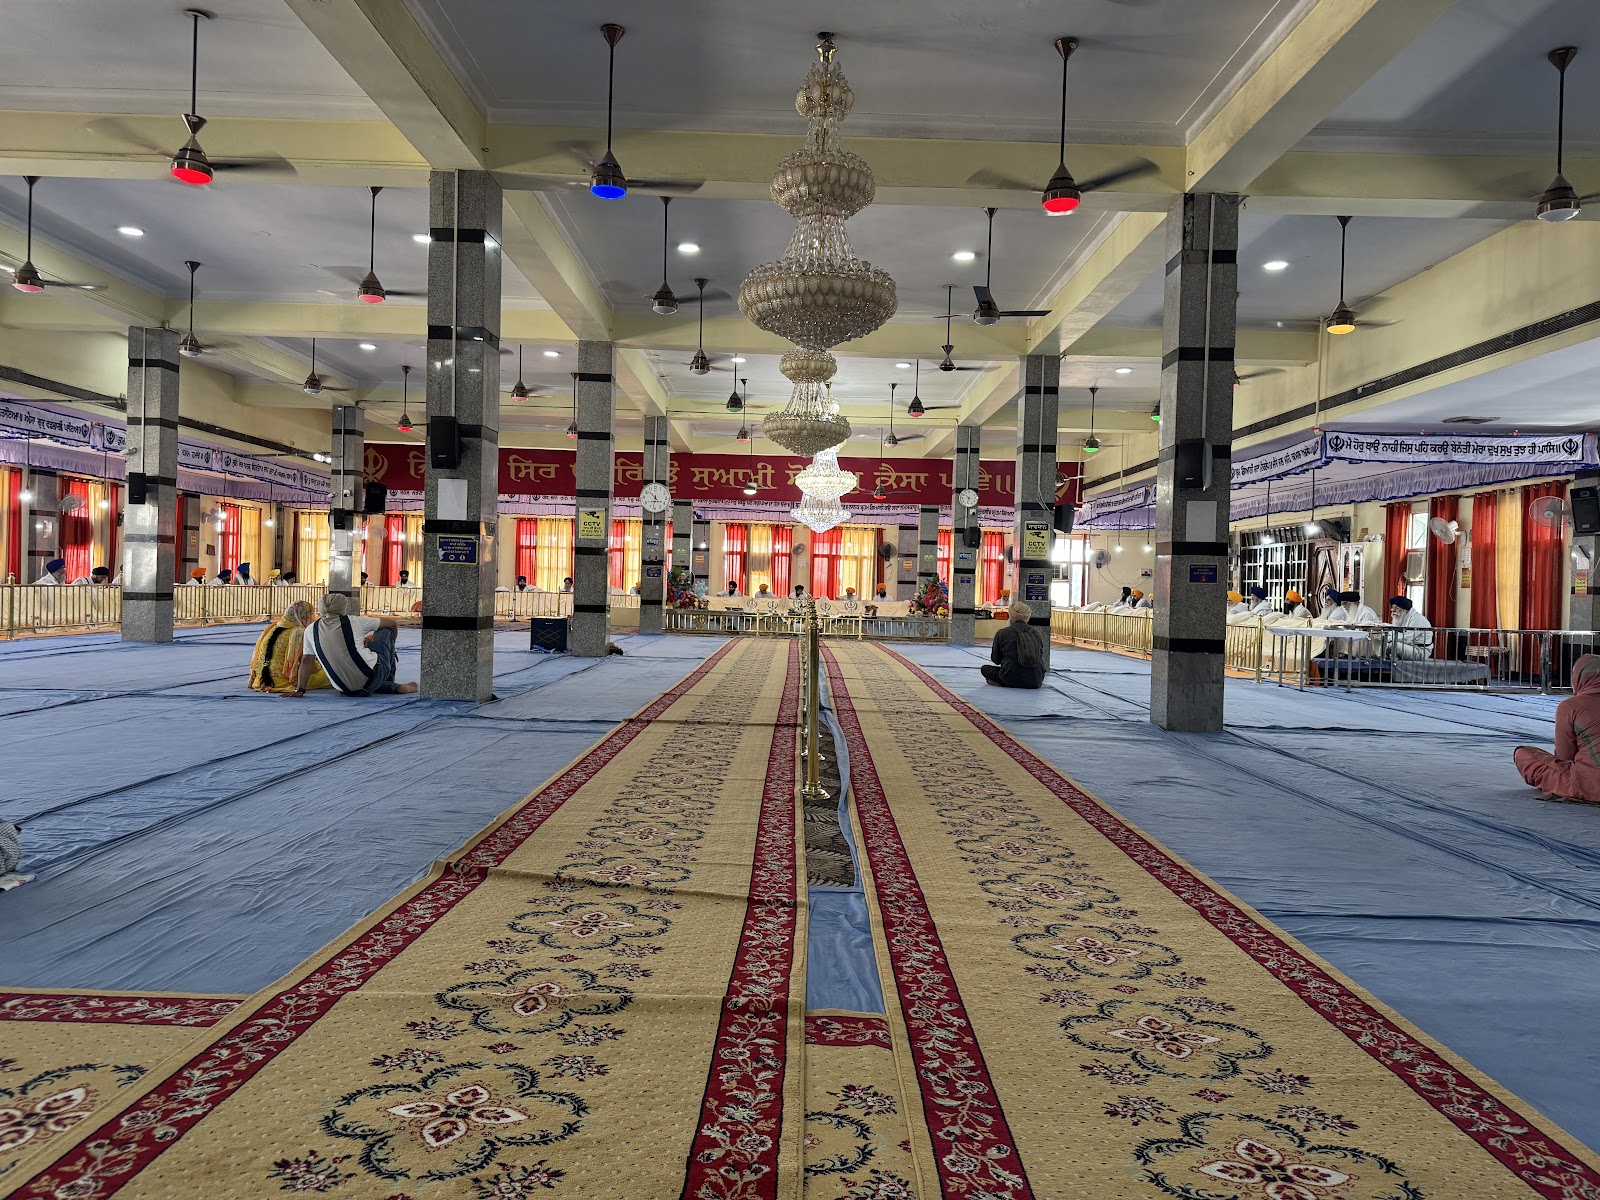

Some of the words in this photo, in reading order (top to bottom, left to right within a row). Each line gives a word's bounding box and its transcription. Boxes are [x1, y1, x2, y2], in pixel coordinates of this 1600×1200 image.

[1345, 436, 1353, 450] ਮੈ
[1353, 437, 1365, 452] ਹੋਰੁ
[1381, 439, 1398, 453] ਨਾਹੀ
[1399, 440, 1413, 454] ਜਿਸੁ
[1414, 440, 1430, 453] ਪਹਿ
[1429, 440, 1449, 454] ਕਰਉ
[1451, 441, 1471, 454] ਬੇਨੰਤੀ
[1471, 441, 1486, 454] ਮੇਰਾ
[1499, 445, 1512, 457] ਸੁਖੁ
[1512, 445, 1525, 457] ਤੁਝ
[1527, 442, 1537, 455] ਹੀ
[507, 454, 560, 483] ਸਿਰ
[690, 462, 777, 491] ਸੁਆਮੀ
[873, 462, 930, 493] ਕੈਸਾ
